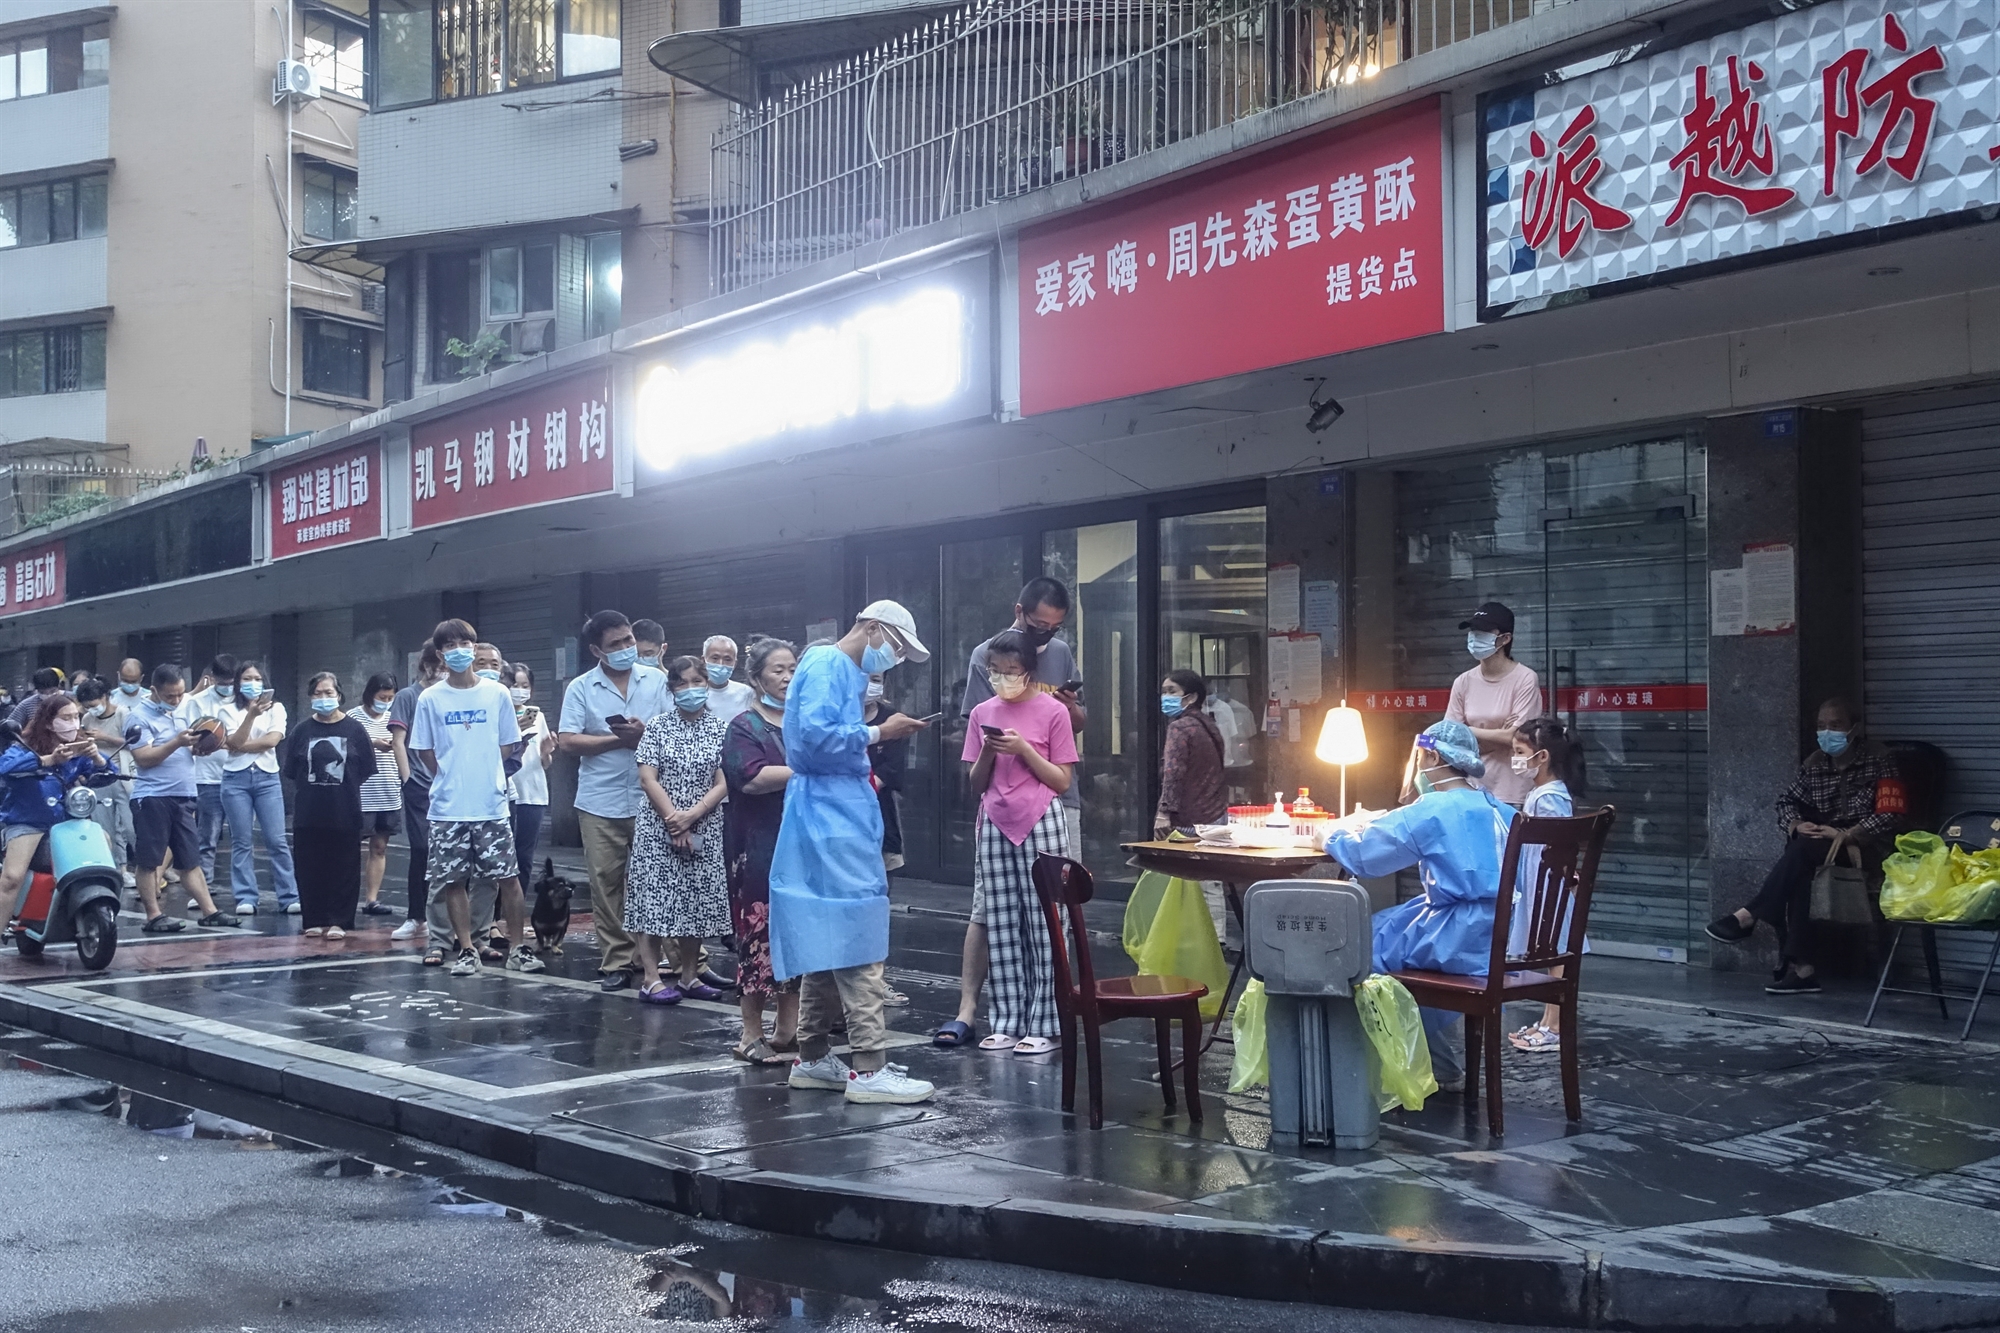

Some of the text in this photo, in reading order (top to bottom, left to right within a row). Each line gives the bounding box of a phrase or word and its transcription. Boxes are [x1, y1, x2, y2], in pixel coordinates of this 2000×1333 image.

[1521, 12, 2000, 259] 派越防
[1035, 156, 1416, 316] 爱家嗨·周先森蛋黄酥
[1326, 247, 1417, 306] 提货点
[415, 400, 606, 501] 凯马钢材钢构
[283, 456, 369, 525] 翔洪建材部
[16, 551, 55, 603] 富昌石材
[1382, 694, 1427, 708] 小心玻璃
[1597, 691, 1653, 706] 小心玻璃
[1276, 920, 1328, 933] 生活垃圾
